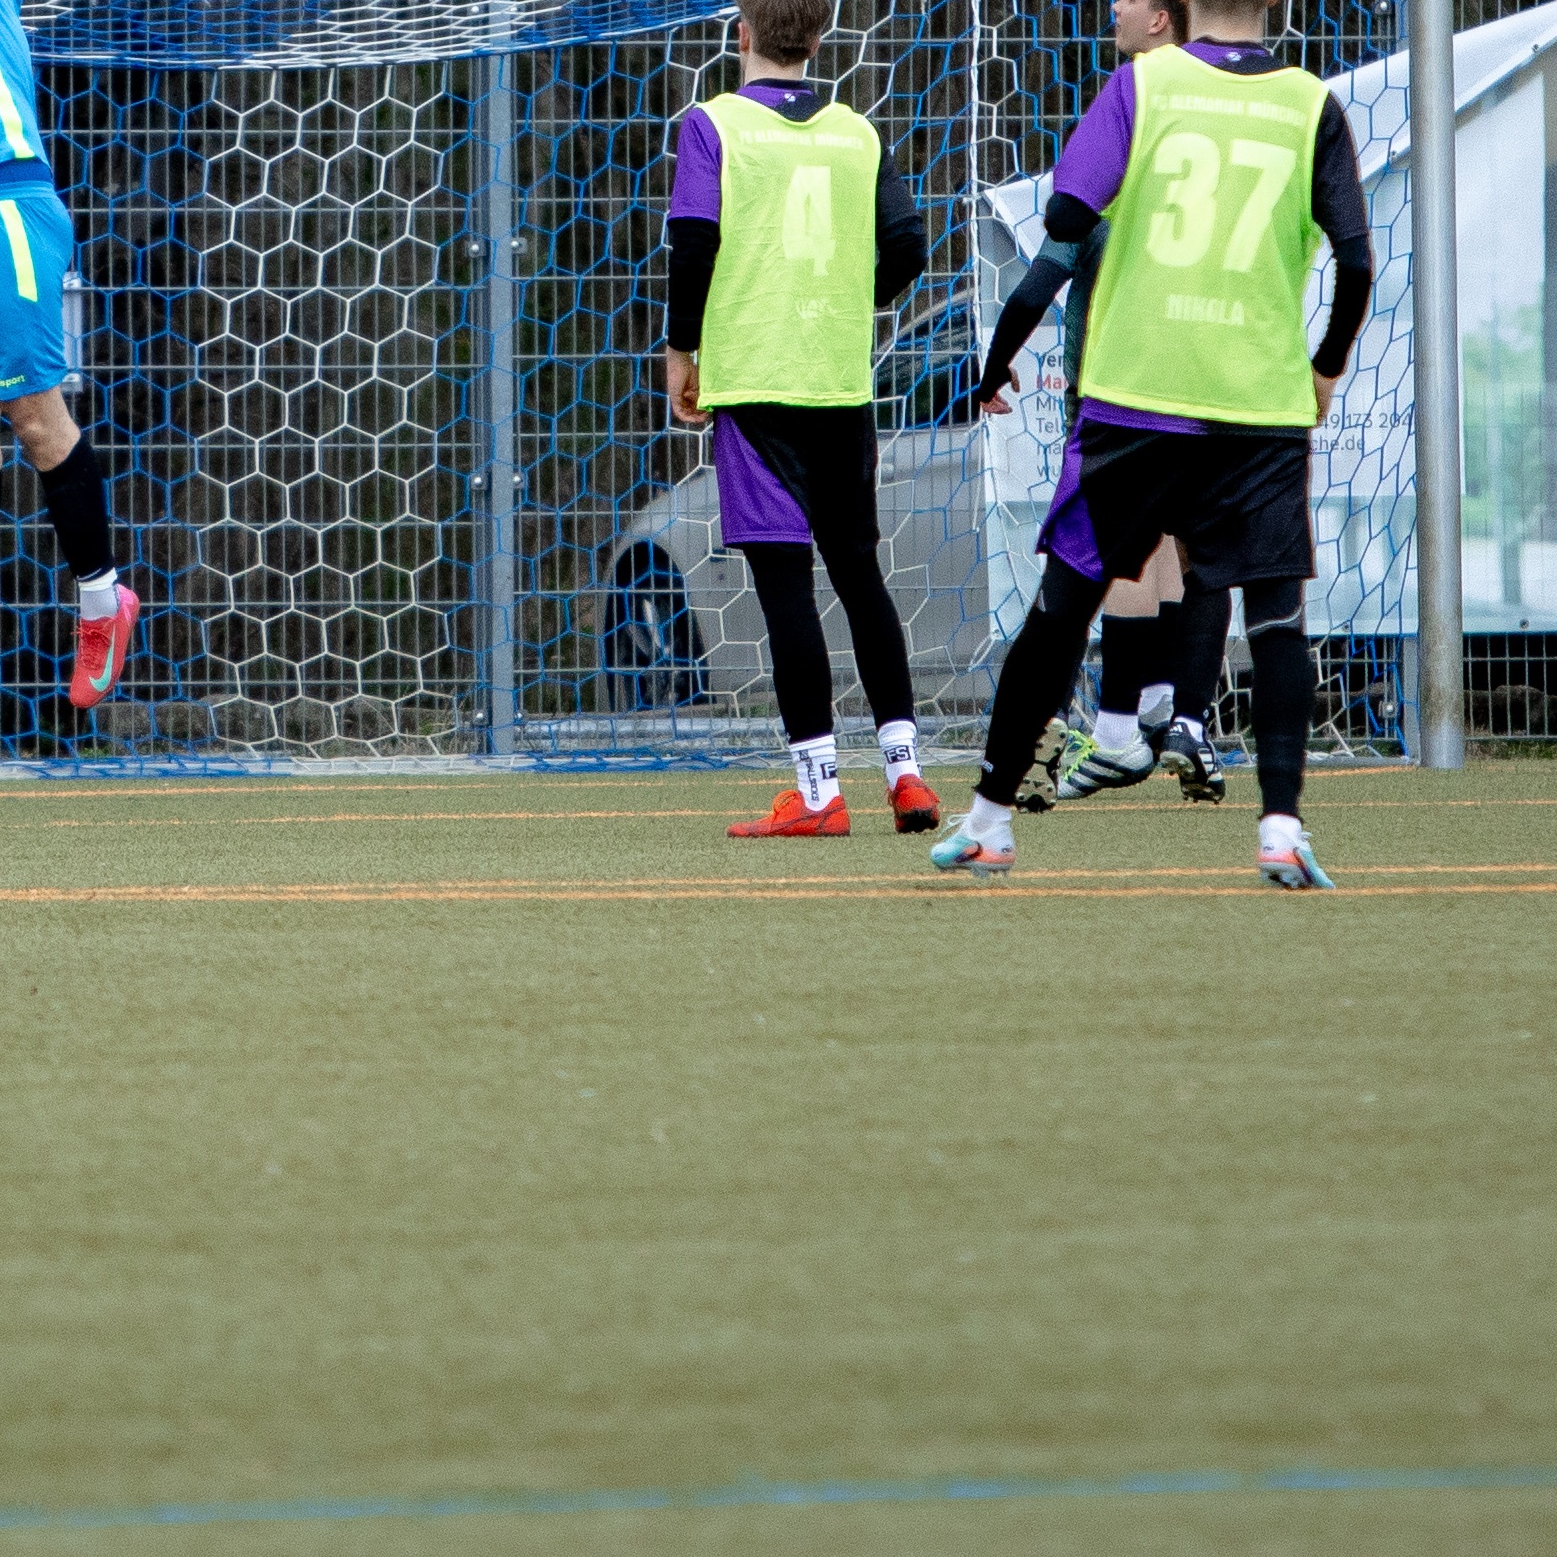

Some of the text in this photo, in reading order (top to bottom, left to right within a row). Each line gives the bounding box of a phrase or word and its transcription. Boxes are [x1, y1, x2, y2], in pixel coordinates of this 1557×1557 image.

[781, 165, 837, 277] 4
[1147, 132, 1298, 273] 37
[1165, 293, 1245, 327] NIKOLA
[886, 746, 910, 763] FS
